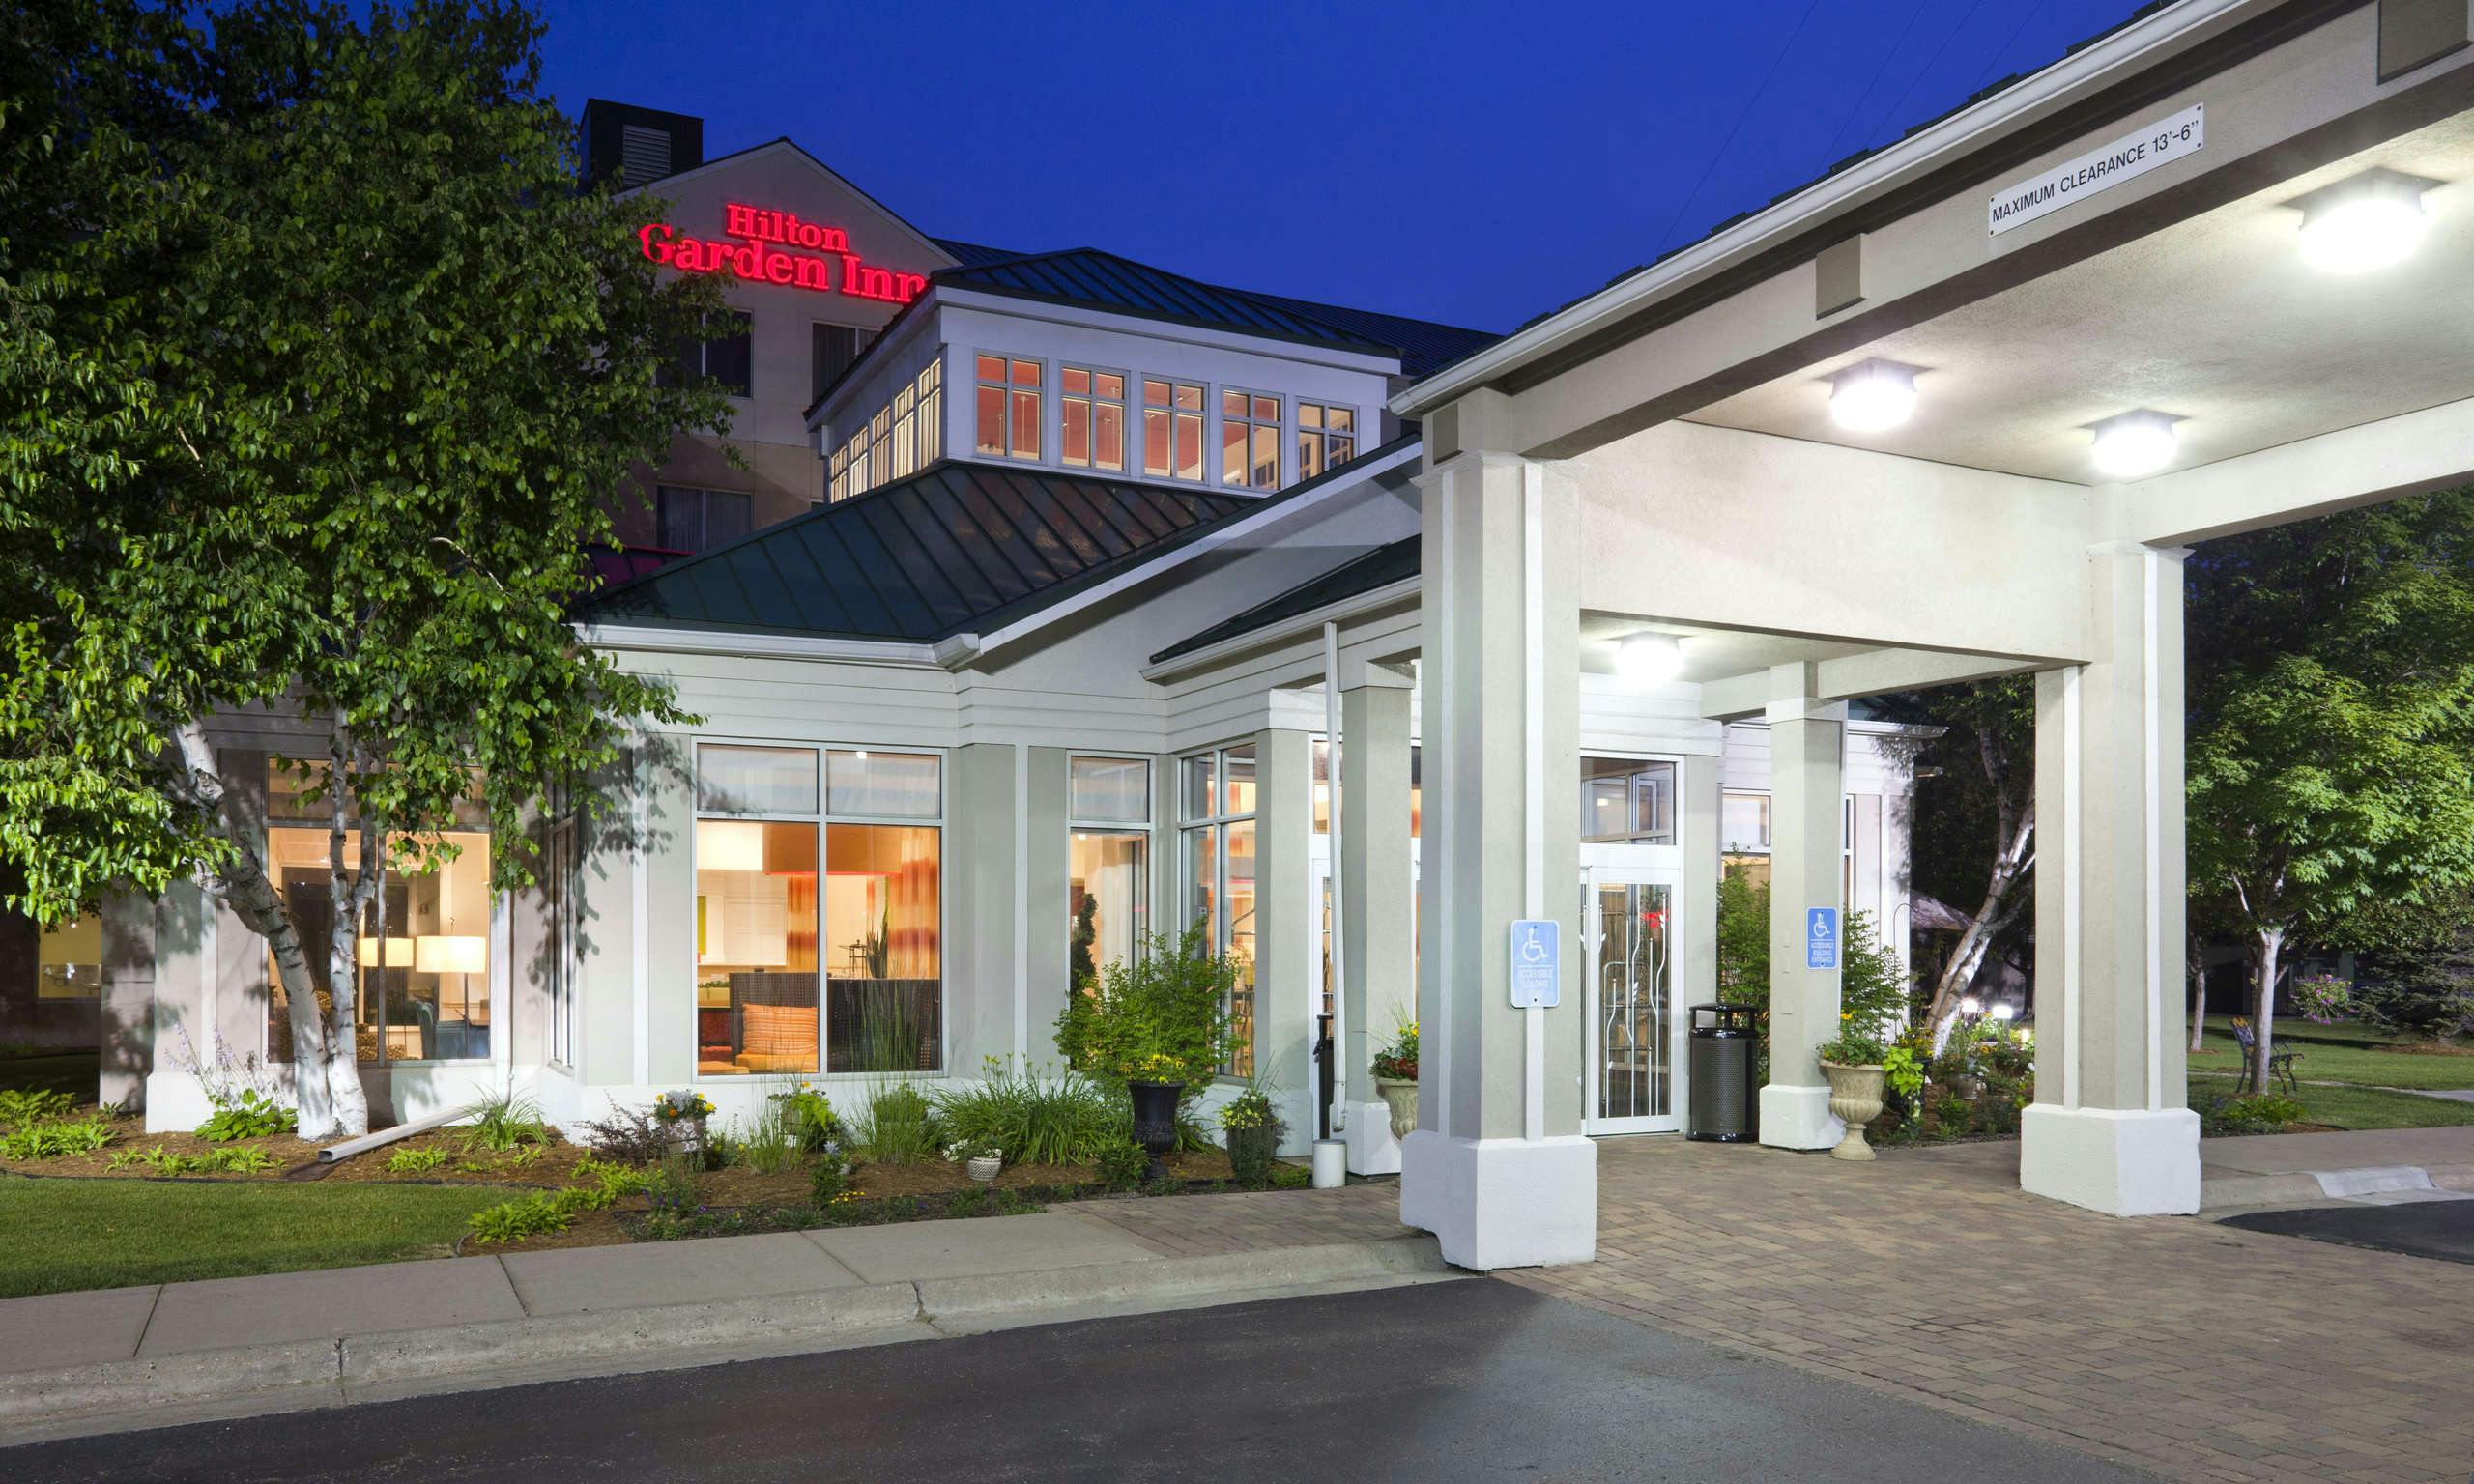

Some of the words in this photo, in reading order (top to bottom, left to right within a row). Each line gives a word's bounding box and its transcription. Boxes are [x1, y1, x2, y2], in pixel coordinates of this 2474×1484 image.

[1992, 184, 2055, 223] MAXIMUM
[2059, 143, 2146, 193] CLEARANCE
[639, 223, 829, 290] Garden
[842, 254, 926, 303] Inn
[727, 203, 849, 253] Hilton
